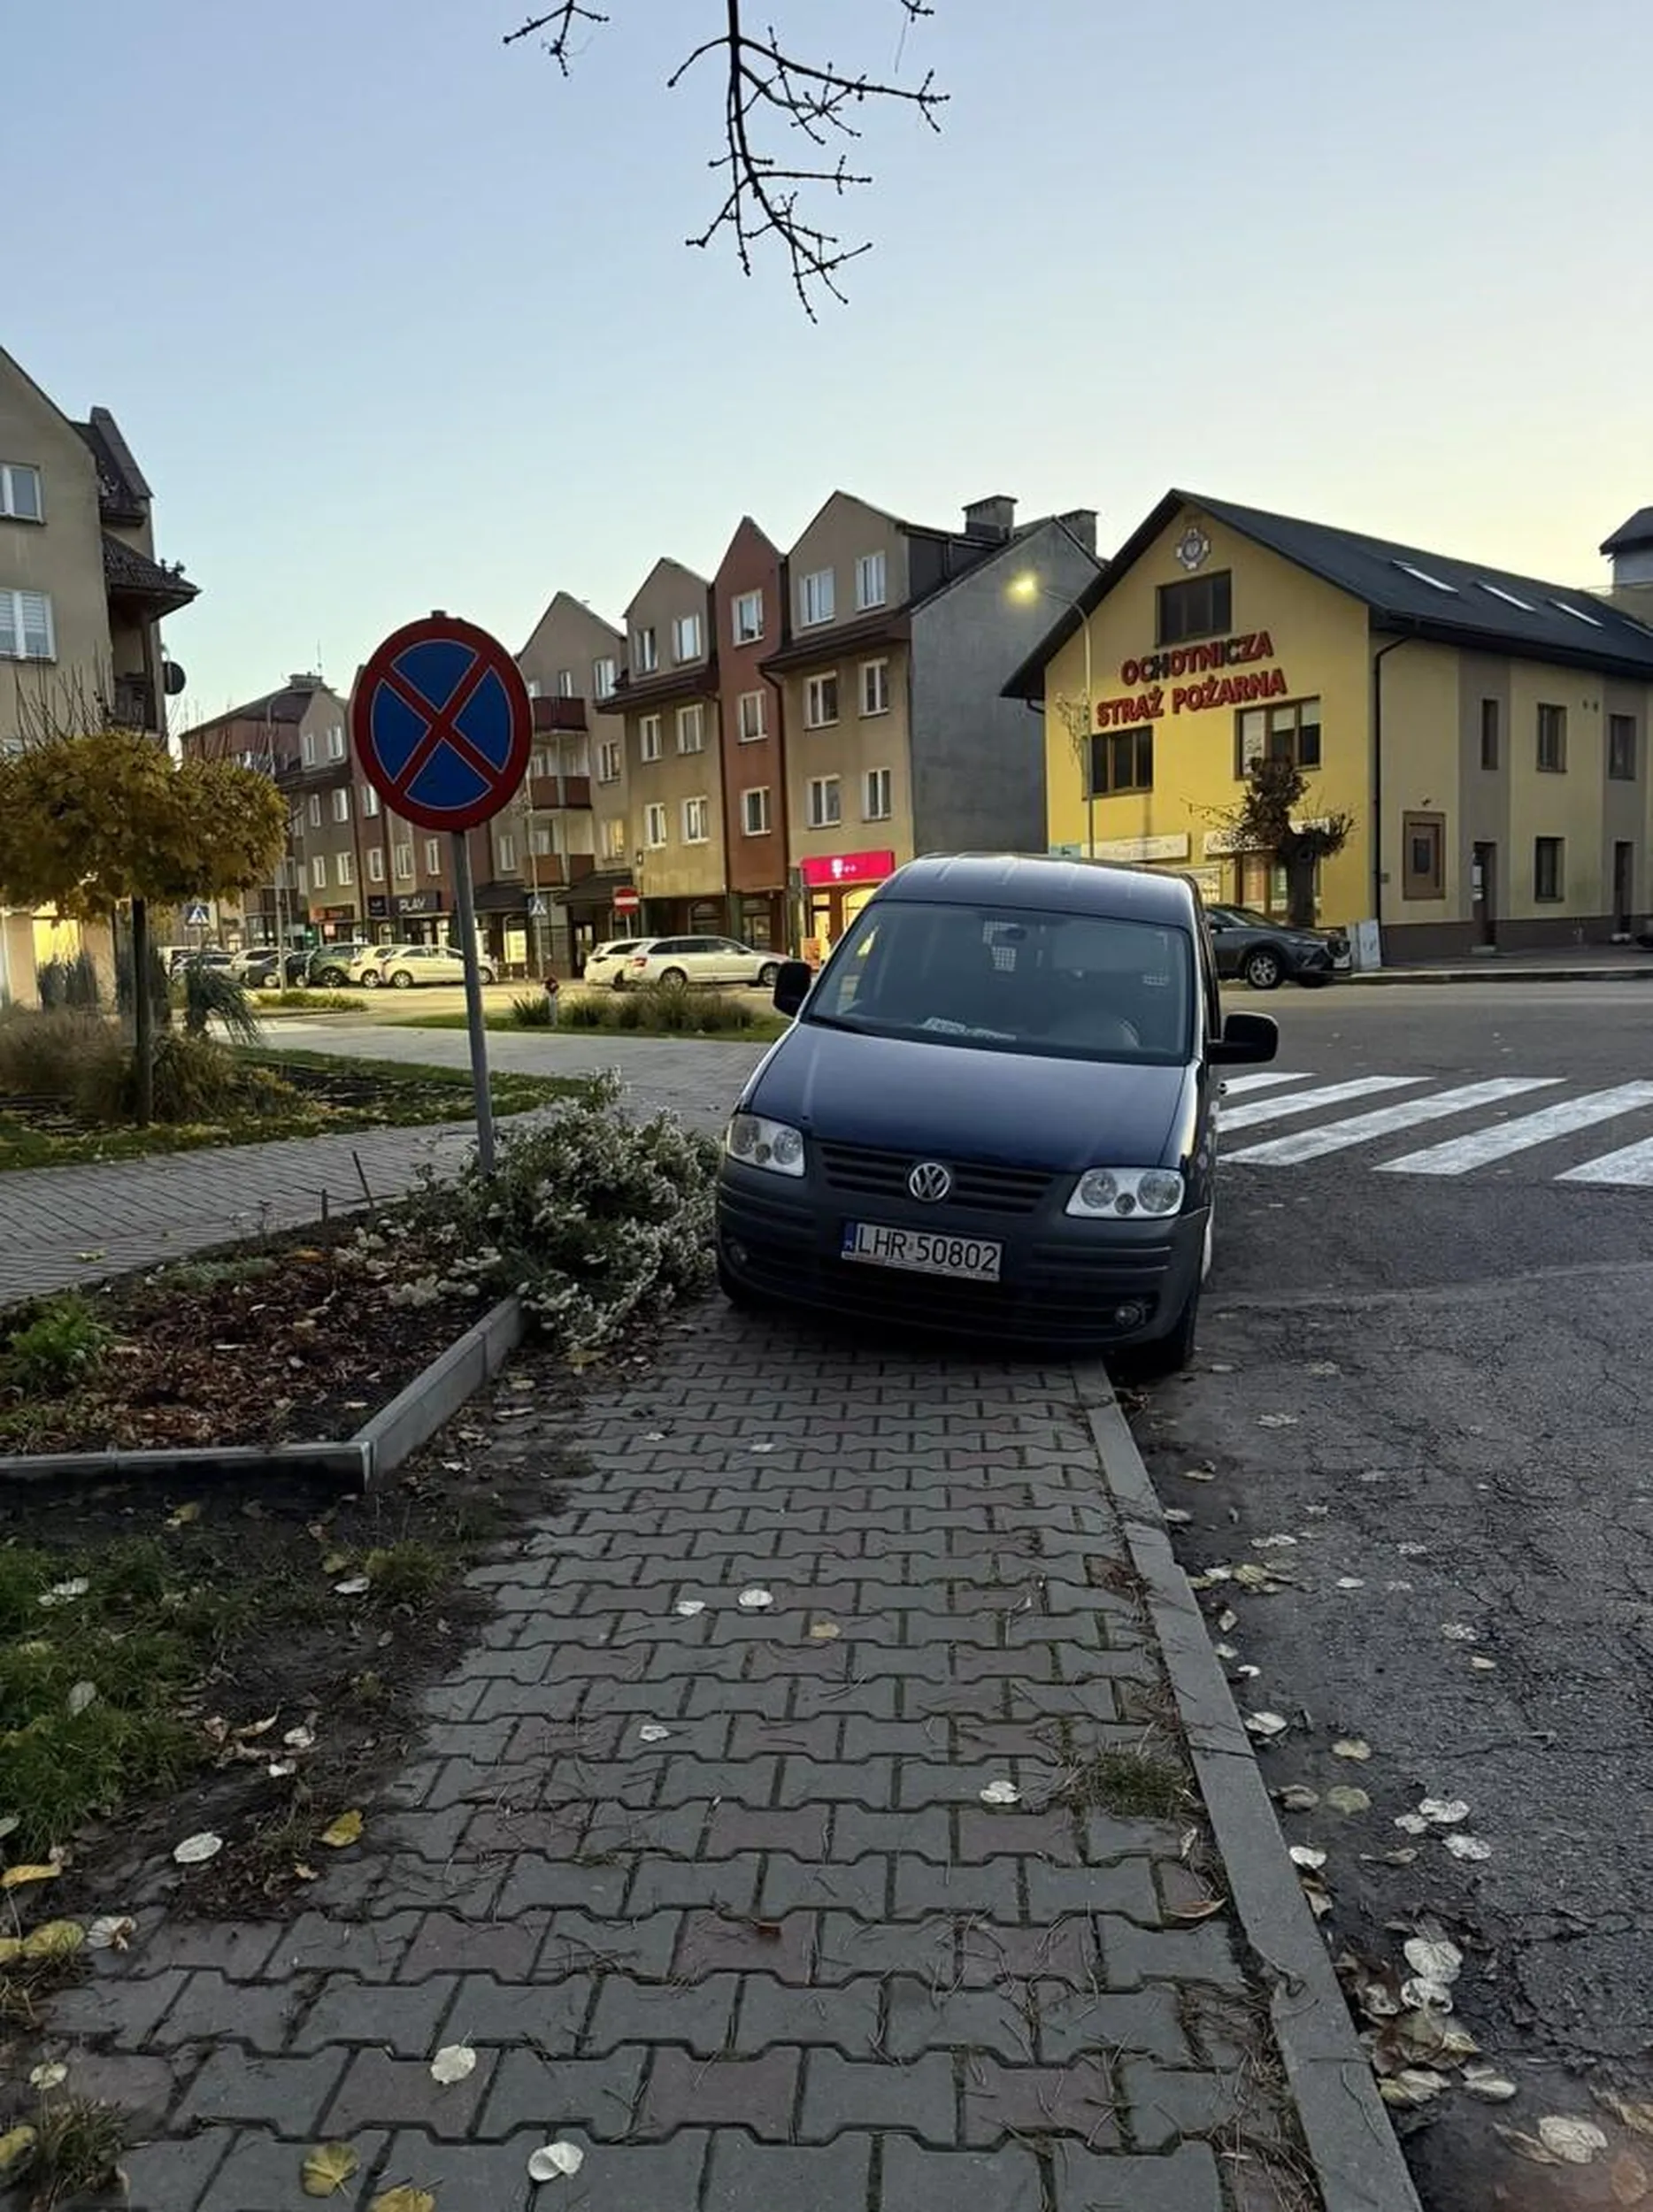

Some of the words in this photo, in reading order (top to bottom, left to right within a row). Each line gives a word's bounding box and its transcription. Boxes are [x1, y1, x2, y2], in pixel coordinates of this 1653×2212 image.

[1121, 630, 1273, 686] OCHOTNICZA
[1096, 686, 1165, 727] STRAŻ
[1172, 667, 1288, 715] POŻARNA
[399, 896, 426, 911] PLAY
[857, 1225, 905, 1260] LHR
[916, 1235, 997, 1271] 50802
